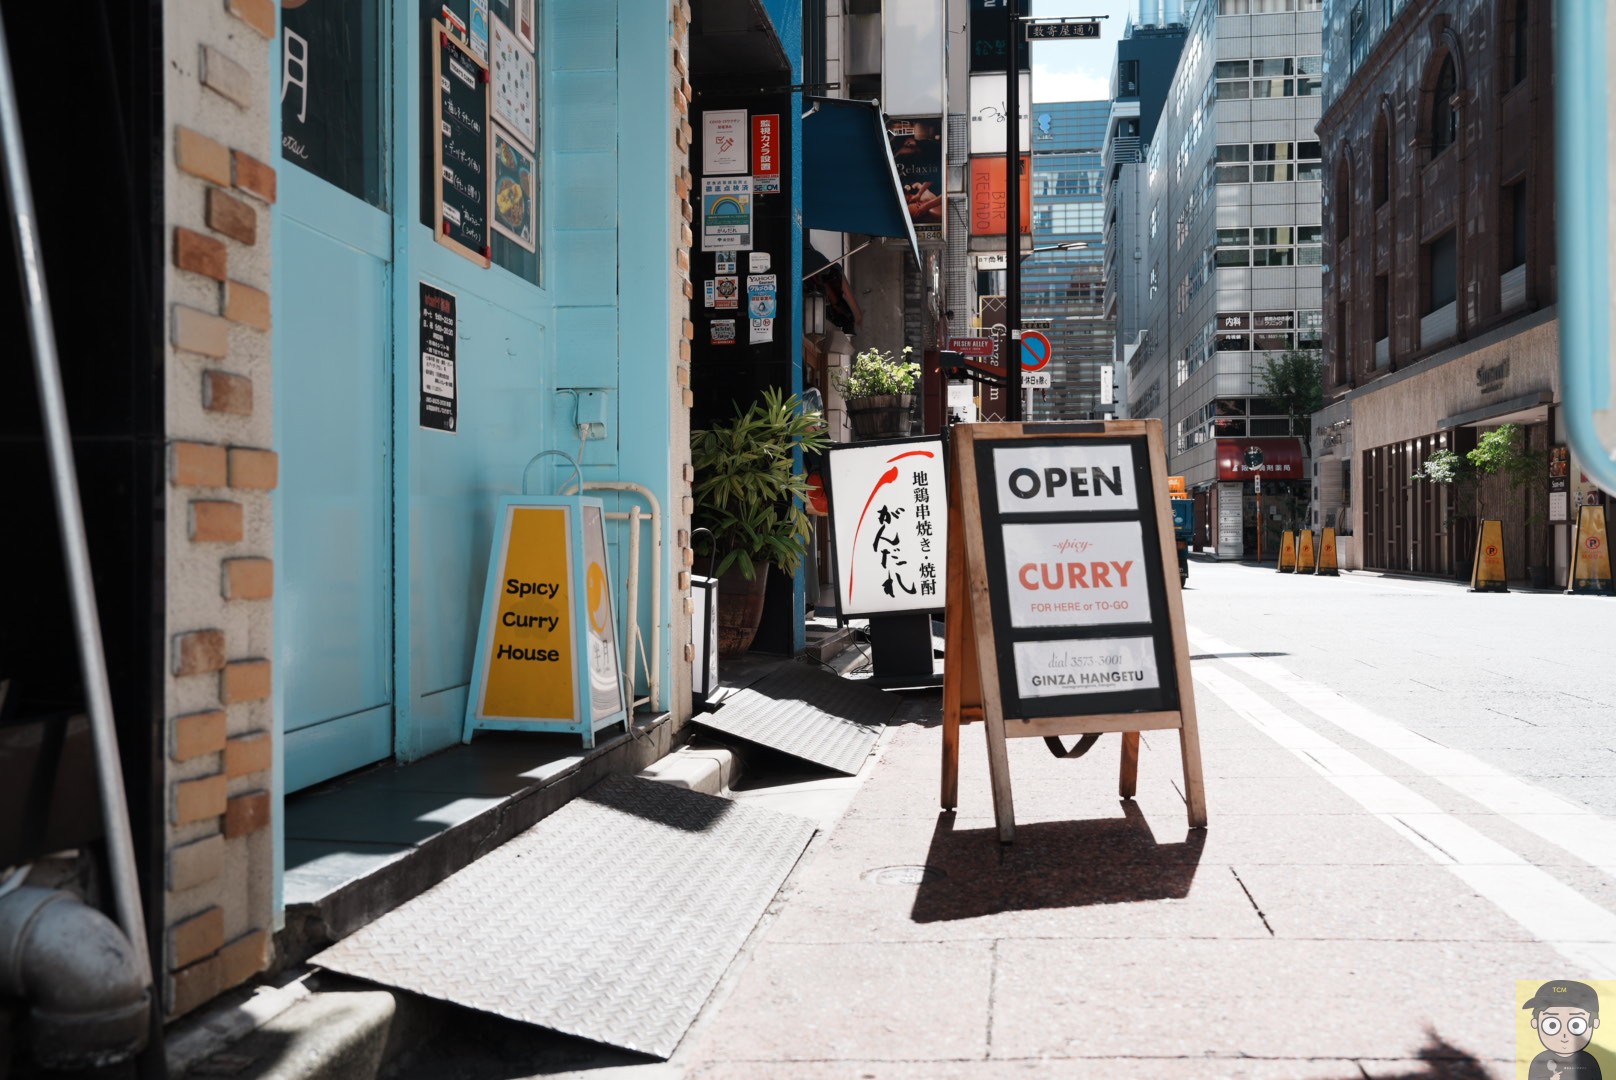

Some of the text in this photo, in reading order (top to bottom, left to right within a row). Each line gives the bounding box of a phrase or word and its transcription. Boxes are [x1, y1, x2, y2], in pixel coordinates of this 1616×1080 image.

[1032, 25, 1095, 38] 数寄屋通り
[760, 119, 771, 171] 監視カメラ設置
[896, 163, 938, 177] Relaxia
[976, 172, 991, 230] RECADO
[992, 191, 1006, 220] BAR
[748, 275, 775, 283] YAHOO!
[1225, 316, 1241, 327] 内科
[1008, 466, 1123, 500] OPEN
[912, 470, 937, 596] 地鶏串焼き・焼酎
[873, 505, 917, 598] がんだれ
[1018, 560, 1134, 591] CURRY
[506, 578, 559, 600] Spicy
[1031, 602, 1052, 612] FOR
[1054, 602, 1081, 612] HERE
[1096, 601, 1128, 610] TO-GO
[502, 612, 560, 632] Curry
[496, 644, 560, 662] House
[1048, 651, 1068, 668] dial
[1032, 674, 1076, 687] GINZA
[1080, 670, 1144, 684] HANGETU
